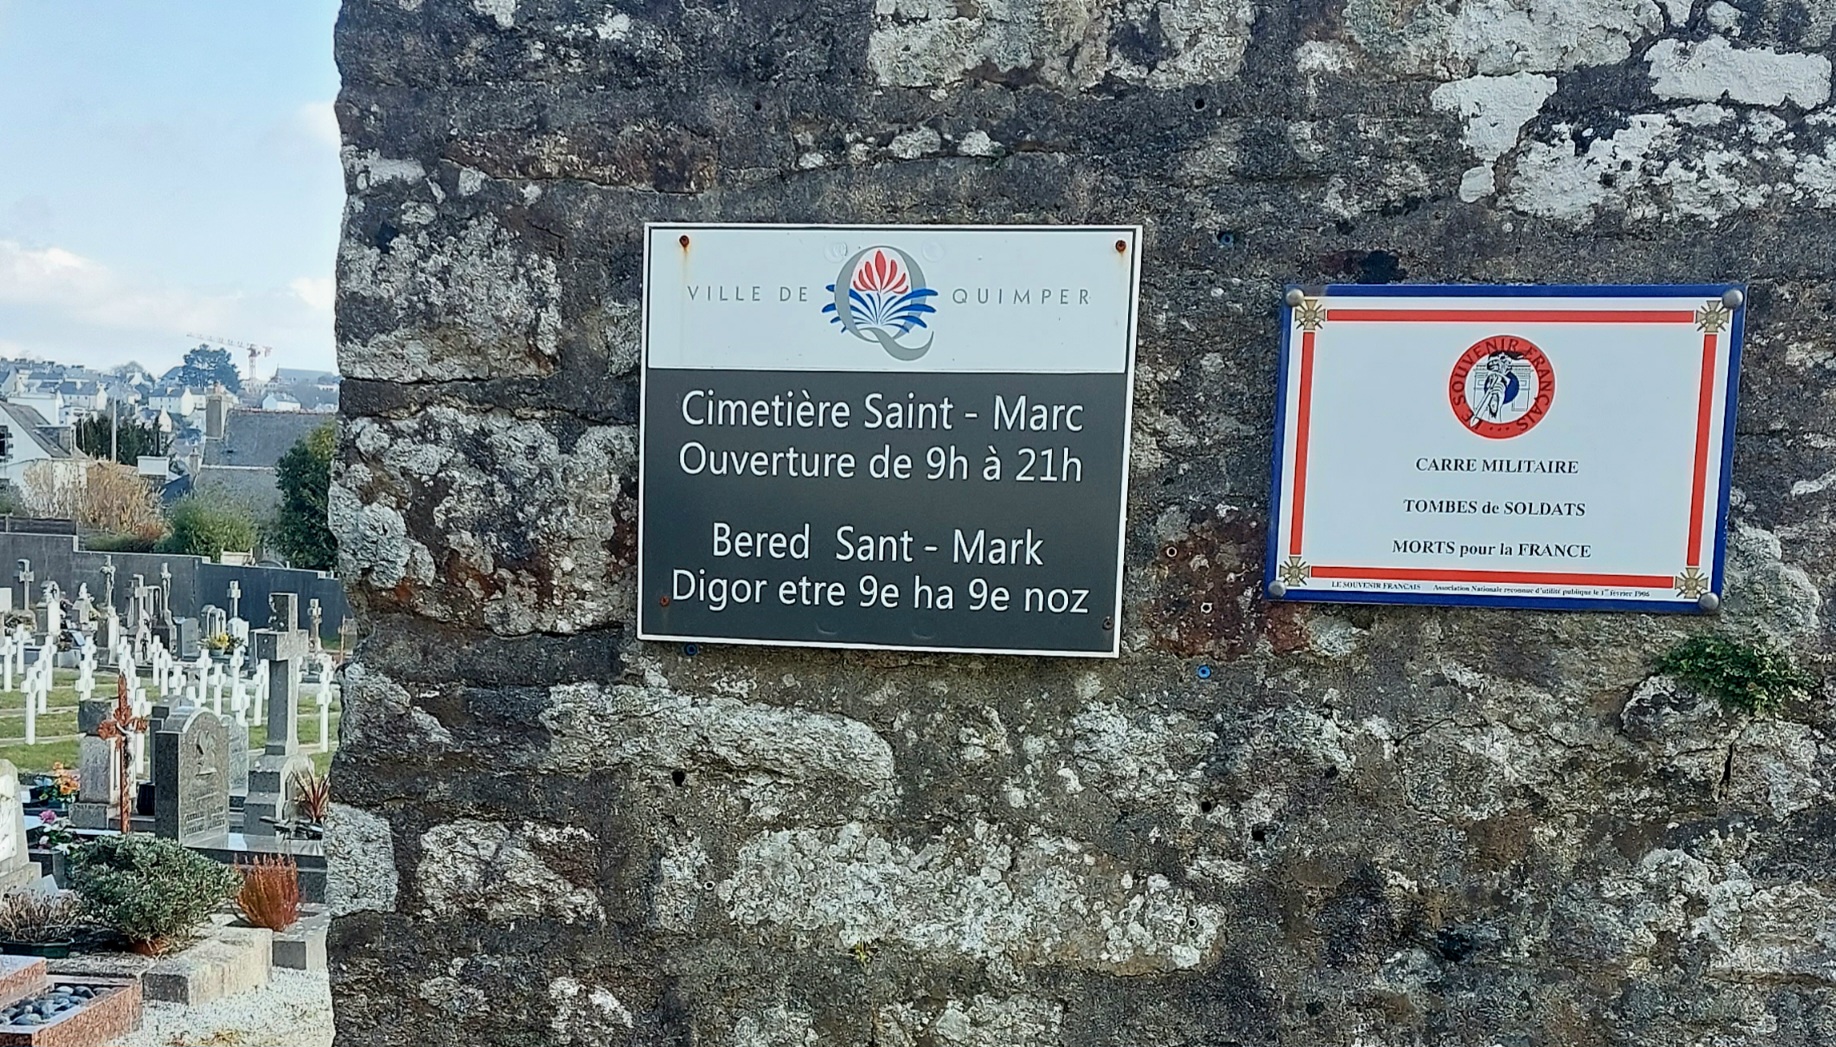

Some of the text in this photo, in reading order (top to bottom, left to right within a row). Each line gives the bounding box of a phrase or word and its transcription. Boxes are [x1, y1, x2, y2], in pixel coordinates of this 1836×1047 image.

[687, 285, 1089, 305] VILLE DE QUIMPER
[1452, 338, 1519, 406] SOUVENIR
[682, 389, 850, 428] Cimetière
[864, 392, 954, 430] Saint
[994, 394, 1083, 432] Marc
[679, 441, 1082, 482] Ouverture de 9h à 21h
[1415, 458, 1579, 474] CARRE MILITAIRE
[1403, 499, 1586, 516] TOMBES de SOLDATS
[713, 522, 810, 559] Bered
[836, 525, 914, 562] Sant
[953, 528, 1044, 565] Mark
[1392, 540, 1591, 558] MORTS pour la FRANCE
[673, 568, 1090, 614] Digor etre 9e ha 9e noz
[1471, 585, 1502, 593] Nationale
